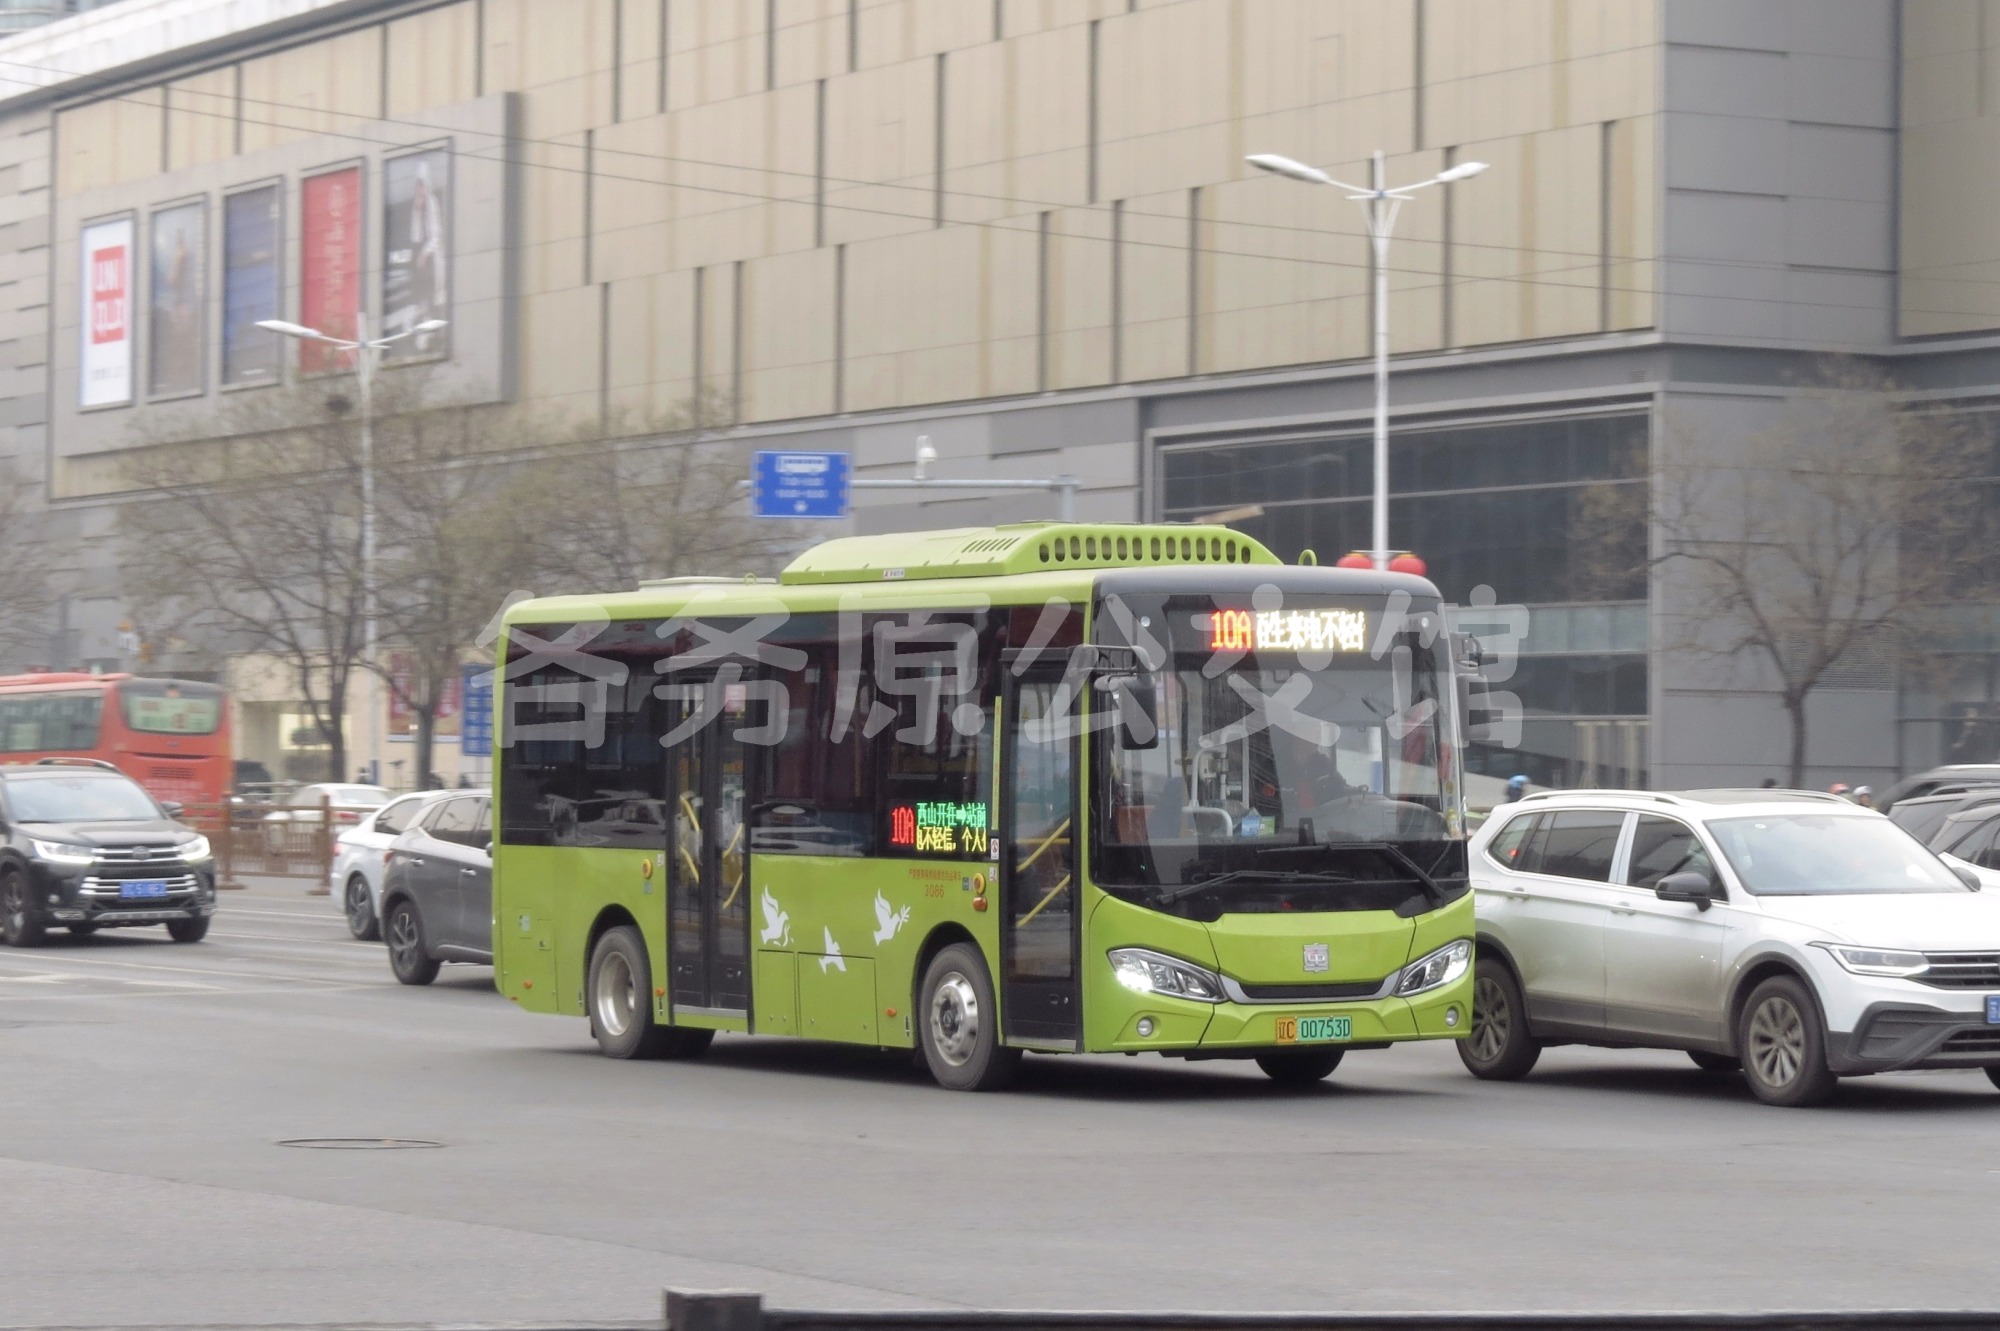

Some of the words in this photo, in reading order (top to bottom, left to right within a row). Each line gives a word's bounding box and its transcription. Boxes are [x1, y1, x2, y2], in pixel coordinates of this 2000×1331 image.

[1211, 610, 1252, 649] 10A
[891, 807, 915, 845] 10A
[1301, 1018, 1351, 1039] 00753D
